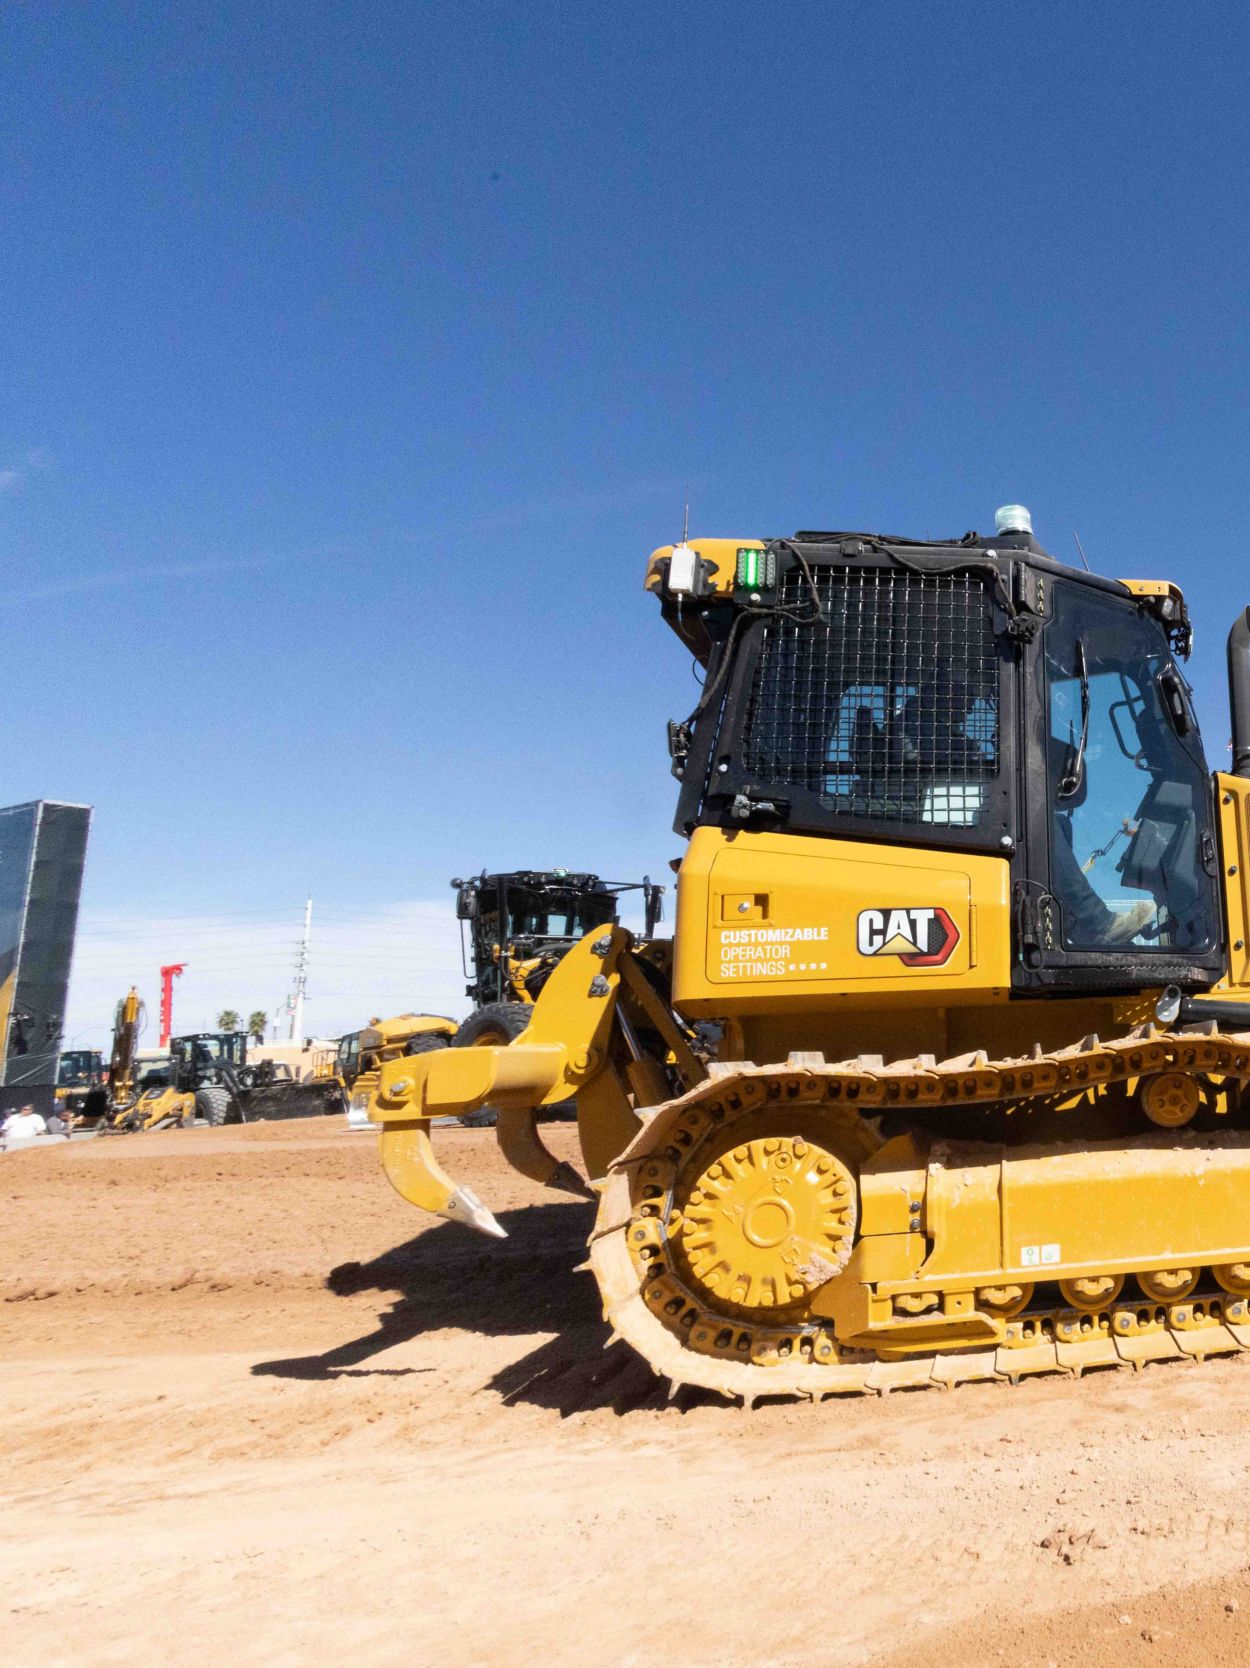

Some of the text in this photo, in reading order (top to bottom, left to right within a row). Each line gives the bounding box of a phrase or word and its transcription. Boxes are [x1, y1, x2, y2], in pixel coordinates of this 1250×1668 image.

[720, 927, 828, 944] CUSTOMIZABLE
[858, 909, 935, 955] CAT
[721, 945, 790, 961] OPERATOR
[720, 961, 785, 977] SETTINGS
